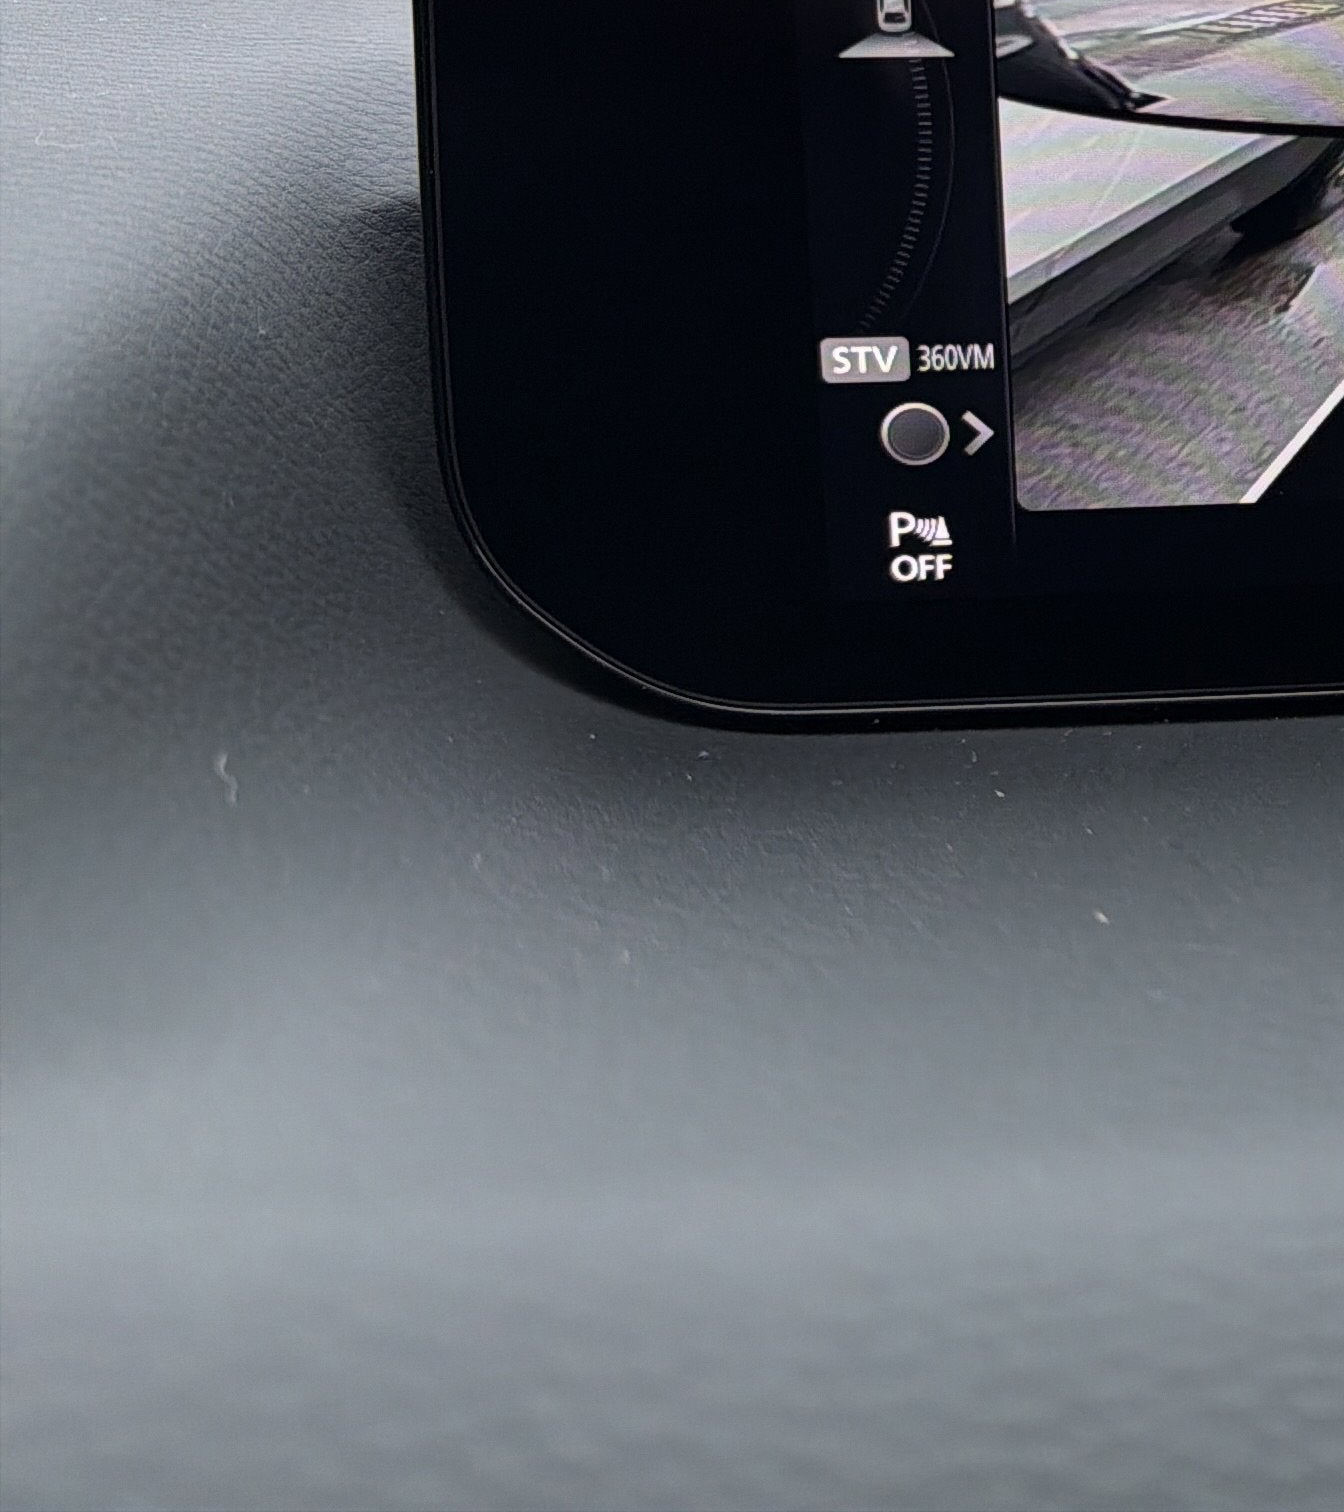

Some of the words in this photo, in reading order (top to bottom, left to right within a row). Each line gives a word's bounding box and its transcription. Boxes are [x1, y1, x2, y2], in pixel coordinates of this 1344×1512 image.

[832, 345, 898, 374] STV
[916, 343, 995, 372] 360VM
[891, 554, 953, 582] OFF
